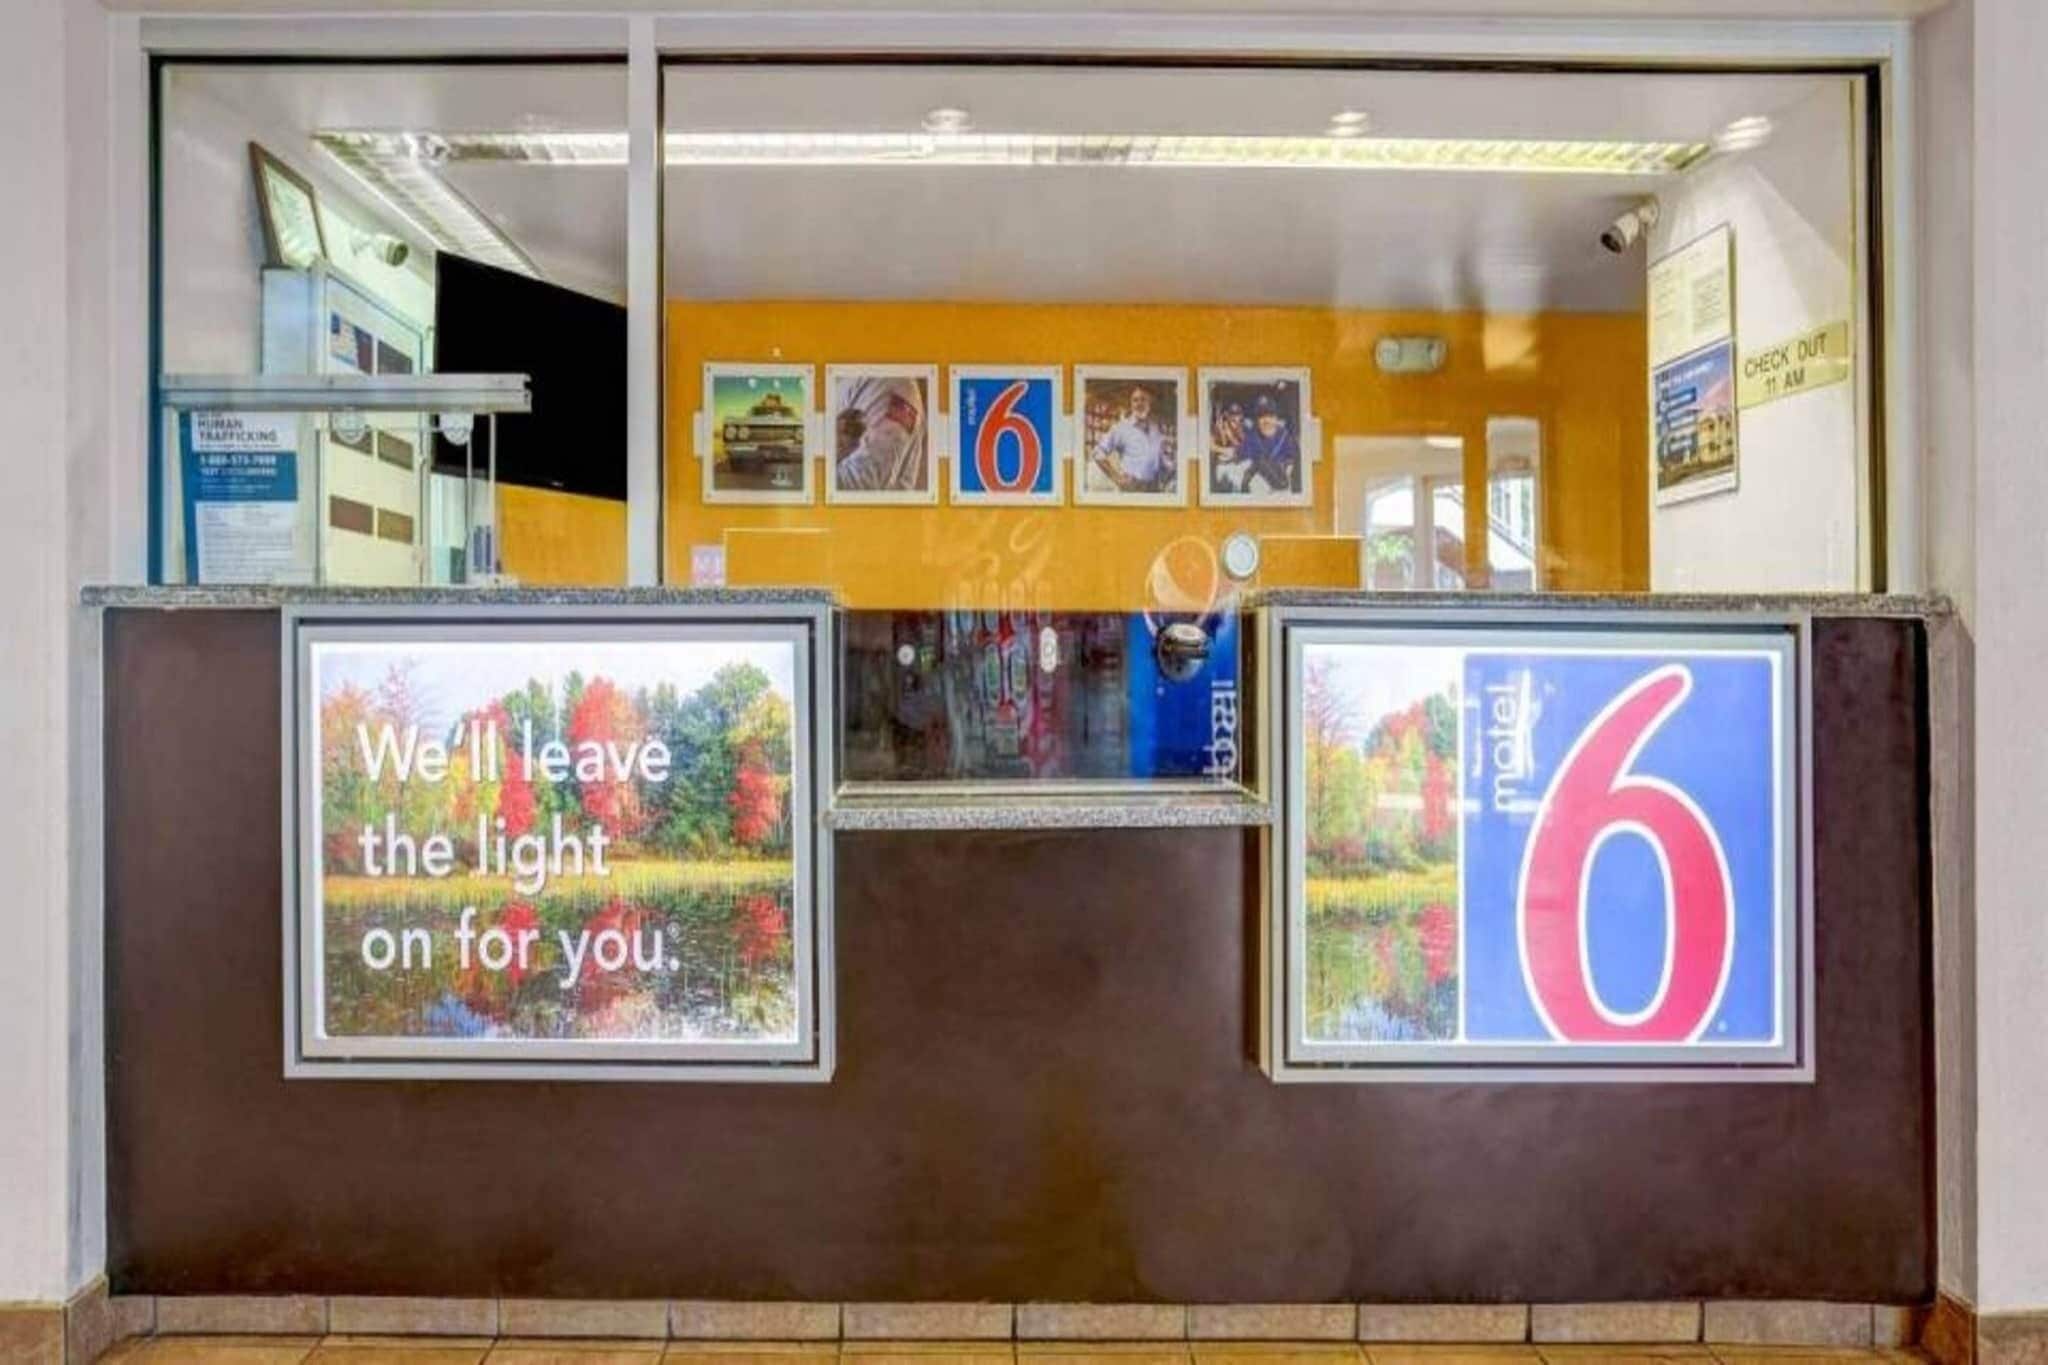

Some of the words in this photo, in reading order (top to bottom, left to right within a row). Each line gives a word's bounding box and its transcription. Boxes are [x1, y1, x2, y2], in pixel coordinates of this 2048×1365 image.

[1744, 345, 1790, 378] CHECK
[1797, 331, 1827, 362] OUT
[1765, 375, 1777, 394] 11
[1784, 367, 1806, 389] AM
[198, 418, 243, 430] HUMAN
[199, 431, 277, 443] TRAFFICKING
[975, 380, 1042, 495] 6
[357, 719, 498, 782] We'll
[524, 719, 673, 783] leave
[358, 813, 456, 877] the
[478, 813, 612, 894] light
[1486, 684, 1518, 812] motel
[1516, 664, 1735, 1042] 6
[361, 925, 433, 971] on
[454, 907, 540, 971] for
